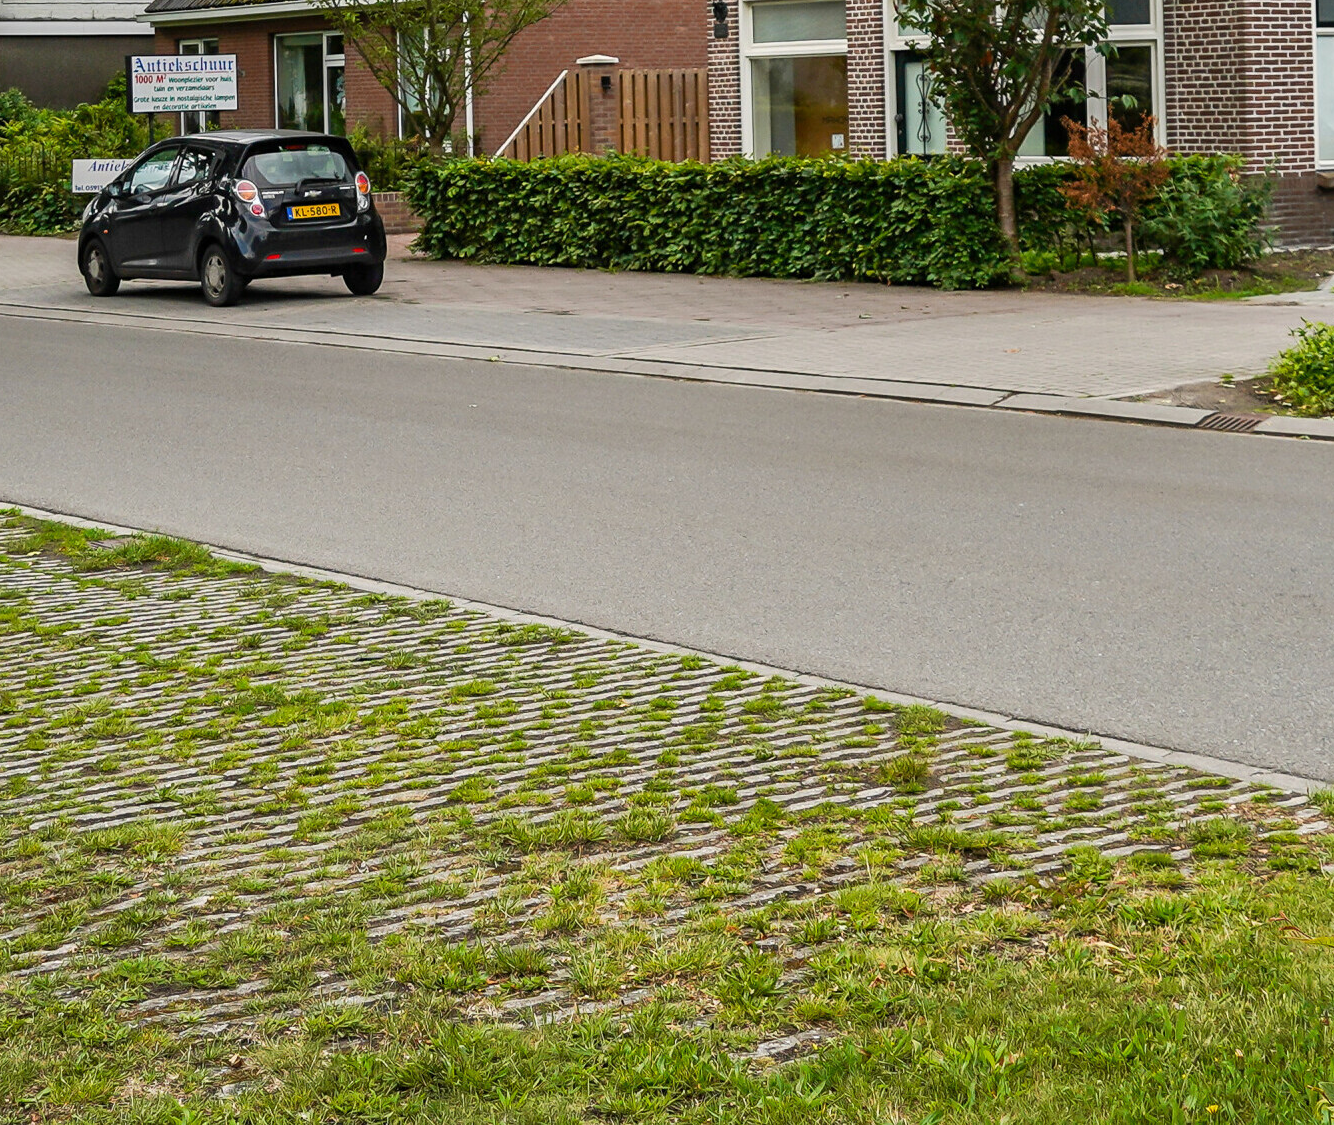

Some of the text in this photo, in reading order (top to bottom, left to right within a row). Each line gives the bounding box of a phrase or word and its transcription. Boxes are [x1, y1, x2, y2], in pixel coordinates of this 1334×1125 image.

[133, 57, 234, 73] Antiekschuur
[135, 75, 153, 84] 1000
[169, 76, 203, 84] Woonplezier
[176, 84, 215, 92] verzamelaars
[151, 95, 167, 103] keuze
[177, 94, 212, 104] nostalgische
[214, 94, 235, 103] lampen
[191, 103, 217, 111] artikelen
[295, 205, 338, 217] KL-580-R
